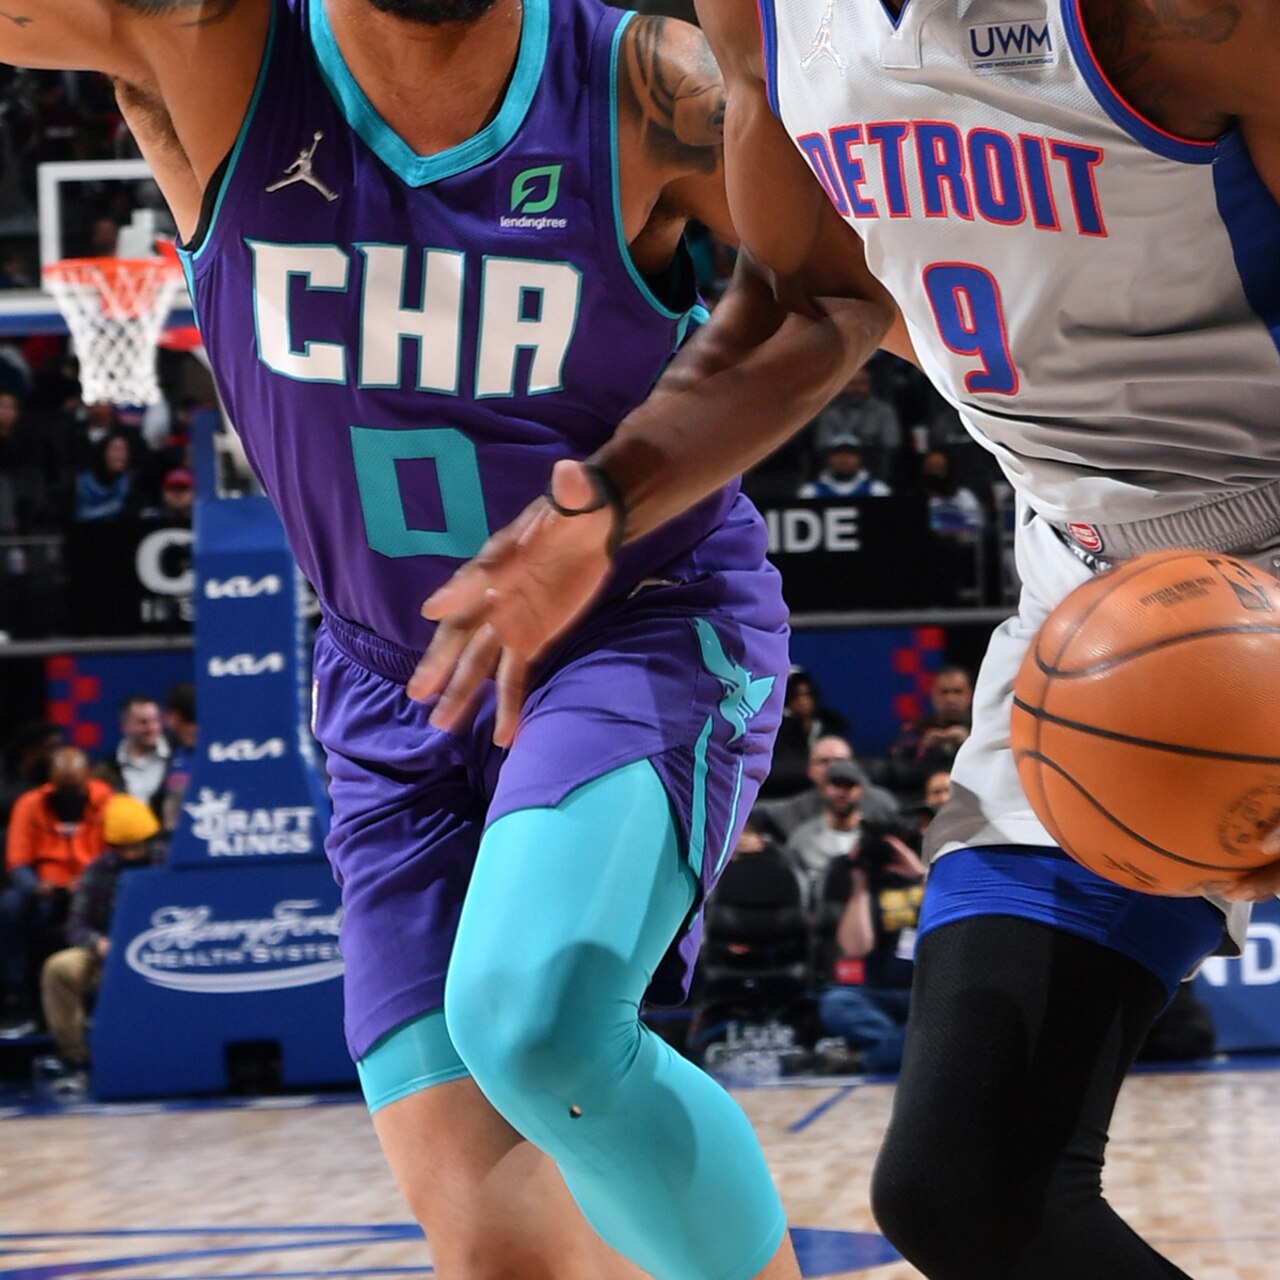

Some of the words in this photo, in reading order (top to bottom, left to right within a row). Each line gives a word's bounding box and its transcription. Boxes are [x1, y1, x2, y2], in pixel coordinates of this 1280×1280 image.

[970, 23, 1052, 57] UWM
[796, 120, 1109, 237] DETROIT
[500, 215, 567, 230] lendingtree
[244, 237, 583, 400] CHA
[922, 260, 1019, 396] 9
[350, 426, 490, 558] 0
[191, 806, 315, 840] DRAFT
[208, 831, 313, 857] KINGS
[141, 949, 244, 969] HEALTH
